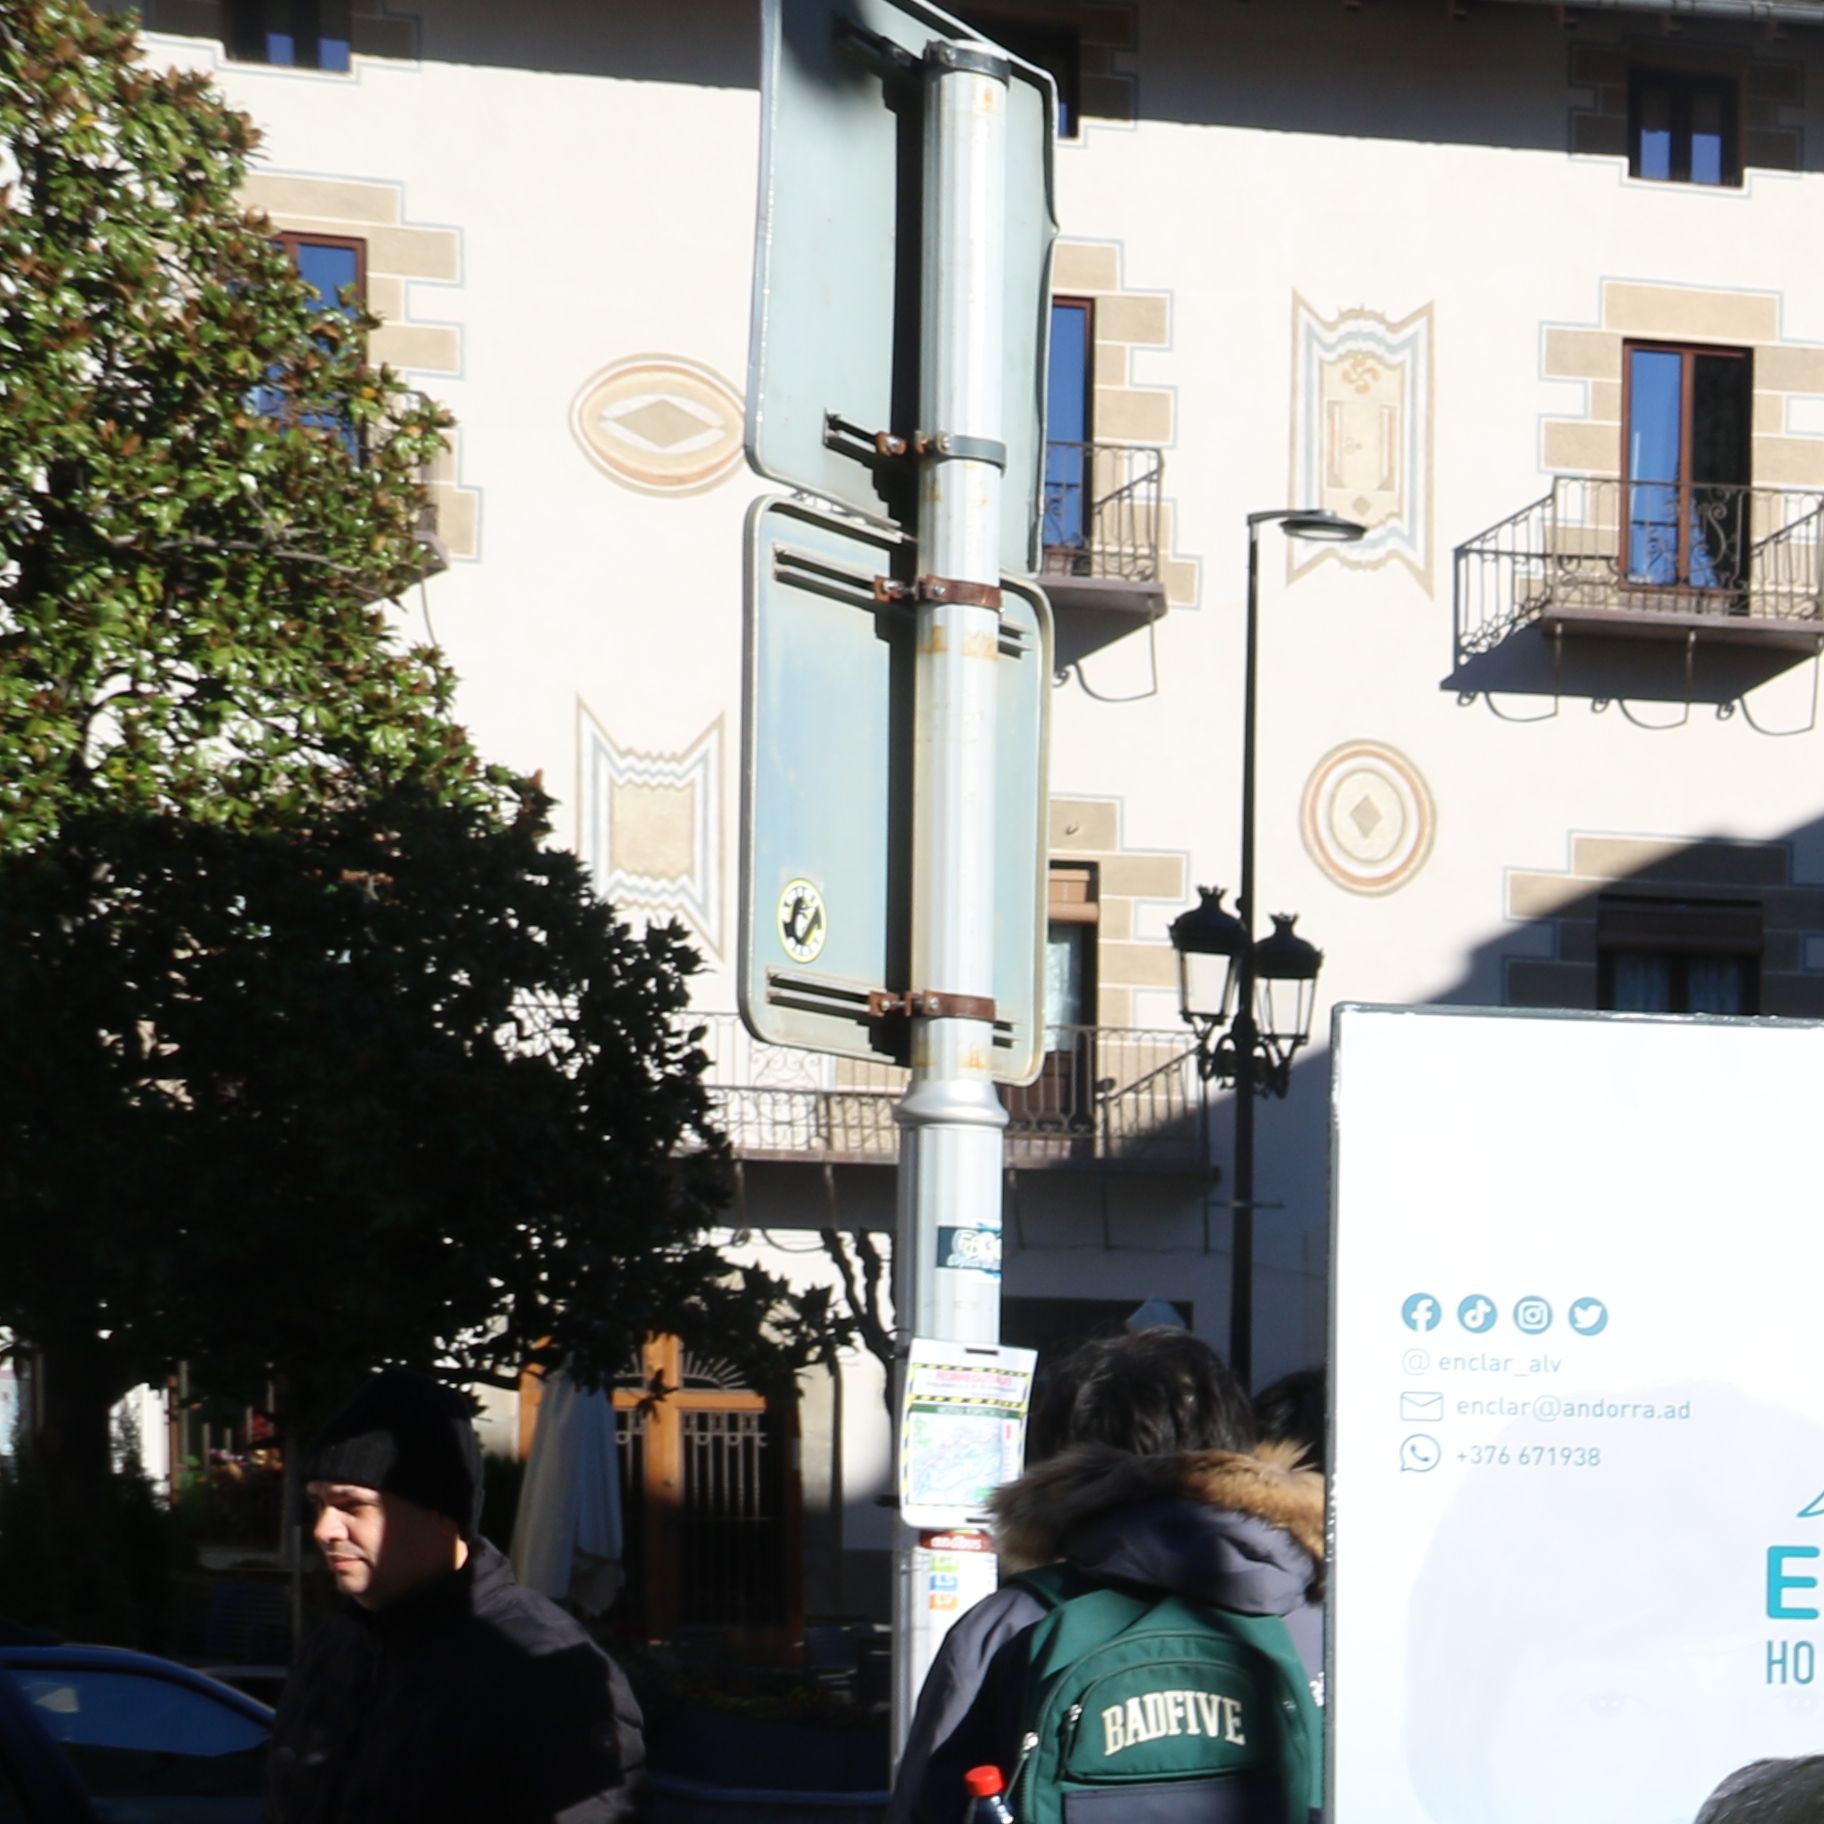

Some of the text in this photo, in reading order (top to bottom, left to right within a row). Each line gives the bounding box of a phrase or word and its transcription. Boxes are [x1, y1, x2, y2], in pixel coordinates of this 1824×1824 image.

[1438, 1353, 1562, 1377] enclar_alv
[1456, 1394, 1691, 1423] enclar@andorra.ad
[1456, 1444, 1601, 1467] +376 671938
[1766, 1640, 1815, 1685] HO
[1101, 1689, 1246, 1757] BADFIVE
